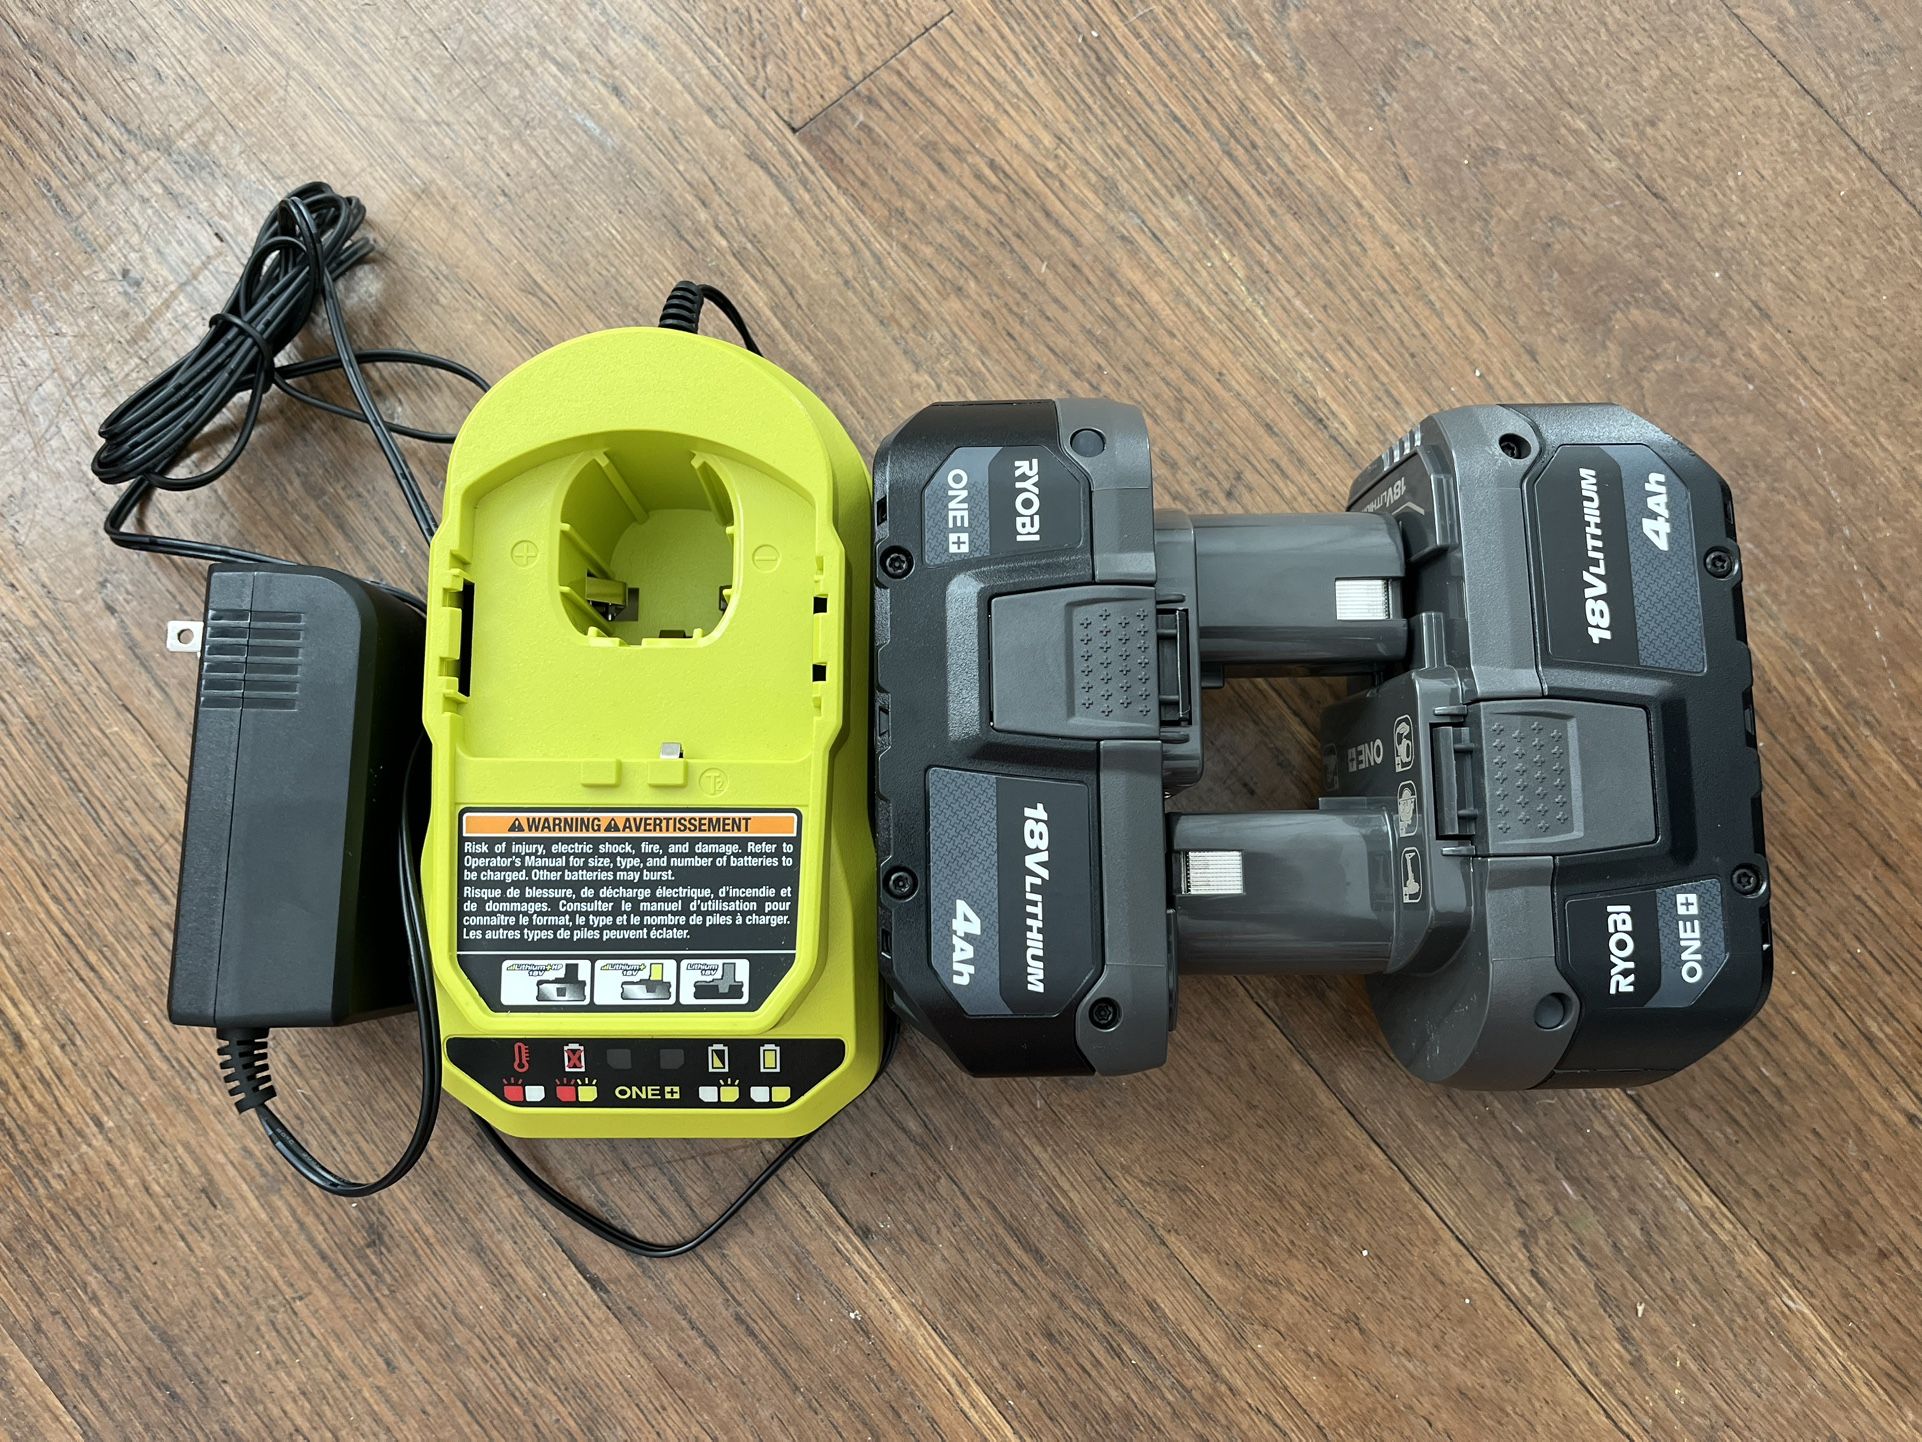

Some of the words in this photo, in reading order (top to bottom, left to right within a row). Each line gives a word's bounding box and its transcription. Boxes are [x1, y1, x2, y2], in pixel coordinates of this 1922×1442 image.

[1014, 458, 1040, 541] RYOBI
[1641, 472, 1671, 551] 4Ah
[526, 817, 601, 832] WARNING
[621, 817, 752, 832] AVERTISSEMENT
[464, 842, 489, 853] Risk
[494, 842, 507, 853] of
[511, 842, 547, 856] injury,
[551, 842, 594, 853] electric
[598, 842, 636, 855] shock,
[640, 842, 663, 855] fire,
[667, 842, 690, 853] and
[694, 842, 742, 856] damage.
[747, 842, 778, 853] Refer
[782, 842, 794, 853] to
[463, 855, 522, 870] Operator's
[524, 855, 566, 867] Manual
[568, 855, 586, 867] for
[587, 855, 614, 869] size,
[615, 855, 644, 870] type,
[645, 855, 668, 867] and
[670, 855, 714, 867] number
[715, 855, 728, 867] of
[729, 855, 779, 867] batteries
[781, 855, 793, 867] to
[463, 869, 478, 881] be
[479, 869, 529, 883] charged.
[531, 869, 563, 881] Other
[564, 869, 614, 881] batteries
[616, 871, 641, 883] may
[642, 869, 676, 881] burst.
[463, 886, 502, 901] Risque
[506, 886, 521, 898] de
[524, 886, 576, 900] blessure,
[580, 886, 595, 898] de
[598, 886, 652, 901] décharge
[655, 886, 715, 901] électrique,
[718, 886, 776, 898] d'incendie
[780, 886, 792, 898] et
[463, 900, 478, 912] de
[484, 900, 552, 914] dommages.
[558, 900, 615, 912] Consulter
[621, 900, 633, 912] le
[639, 900, 682, 912] manuel
[689, 900, 758, 912] d'utilisation
[764, 902, 792, 914] pour
[462, 913, 516, 925] connaître
[518, 913, 530, 925] le
[531, 913, 573, 927] format,
[575, 913, 586, 925] le
[588, 913, 614, 928] type
[615, 913, 628, 925] et
[630, 913, 641, 925] le
[643, 913, 687, 925] nombre
[688, 913, 703, 925] de
[705, 913, 733, 928] piles
[735, 913, 743, 925] à
[745, 913, 791, 928] charger.
[462, 927, 483, 939] Les
[484, 927, 521, 939] autres
[523, 927, 554, 942] types
[556, 927, 571, 939] de
[573, 927, 601, 942] piles
[602, 927, 648, 942] peuvent
[649, 927, 691, 939] éclater.
[952, 899, 981, 986] 4Ah
[1606, 905, 1635, 994] RYOBI
